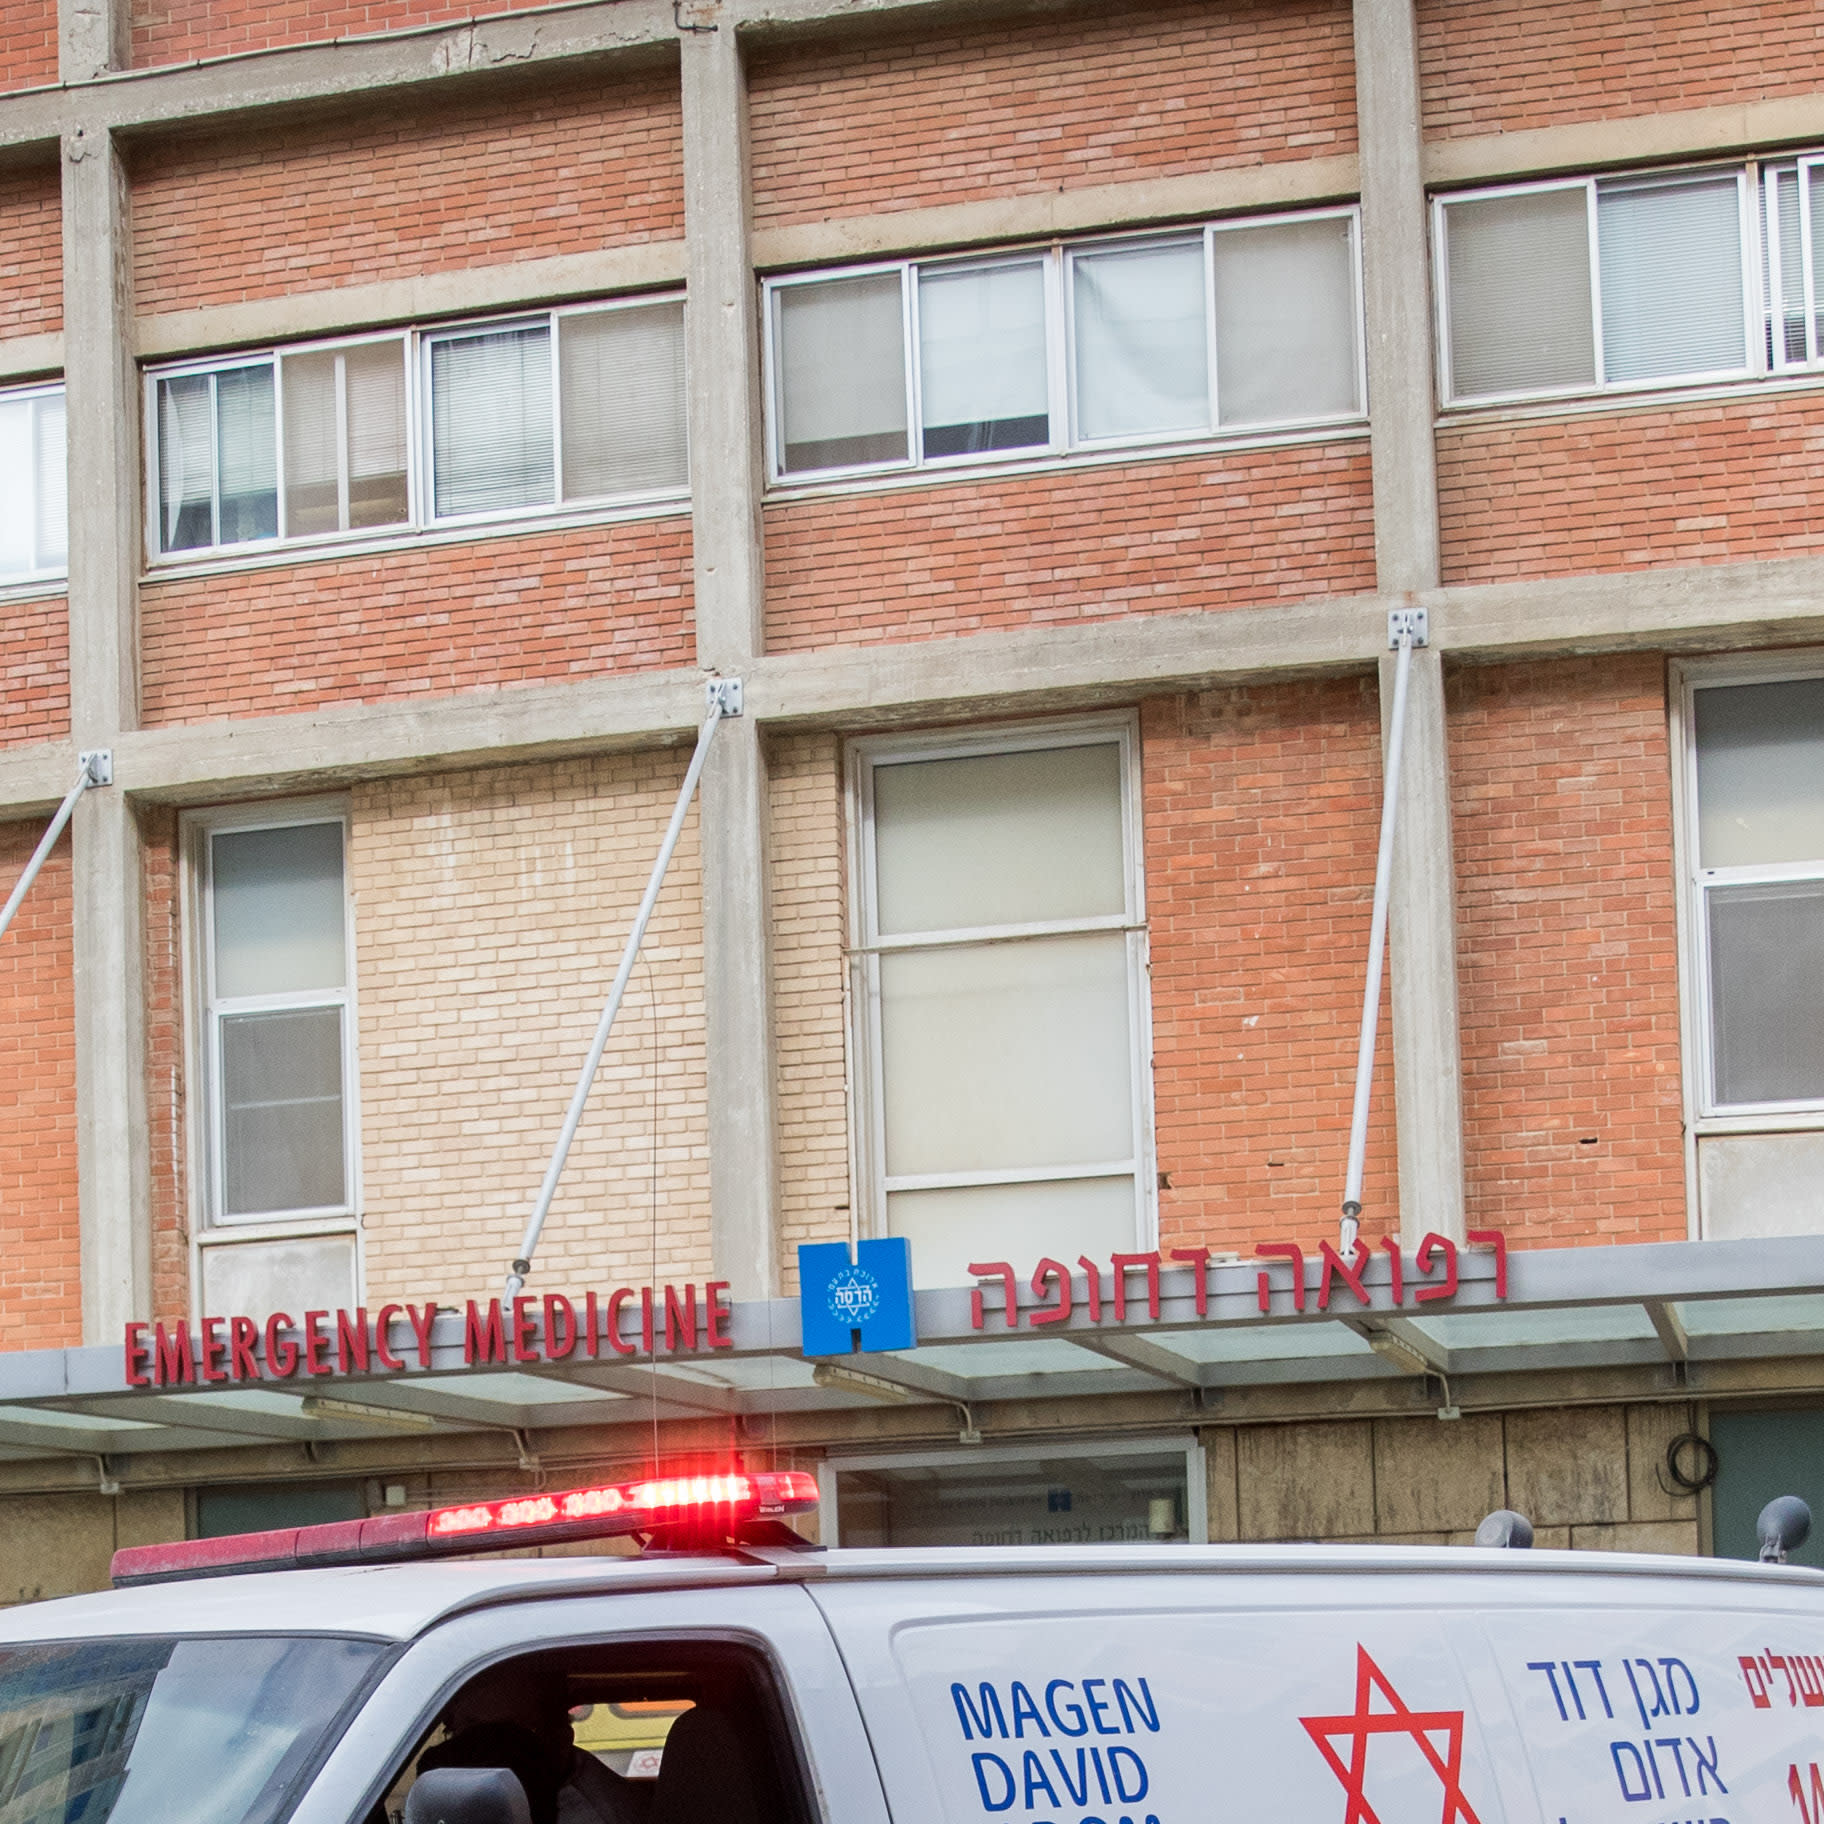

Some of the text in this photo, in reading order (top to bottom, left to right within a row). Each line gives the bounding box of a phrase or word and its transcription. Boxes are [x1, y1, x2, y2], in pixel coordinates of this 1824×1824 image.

[967, 1229, 1507, 1330] רפואה דחופה
[124, 1281, 734, 1386] EMERGENCY MEDICINE
[950, 1677, 1161, 1740] MAGEN
[1526, 1657, 1701, 1730] מגן דוד
[971, 1746, 1149, 1812] DAVID
[1609, 1735, 1729, 1802] אדום
